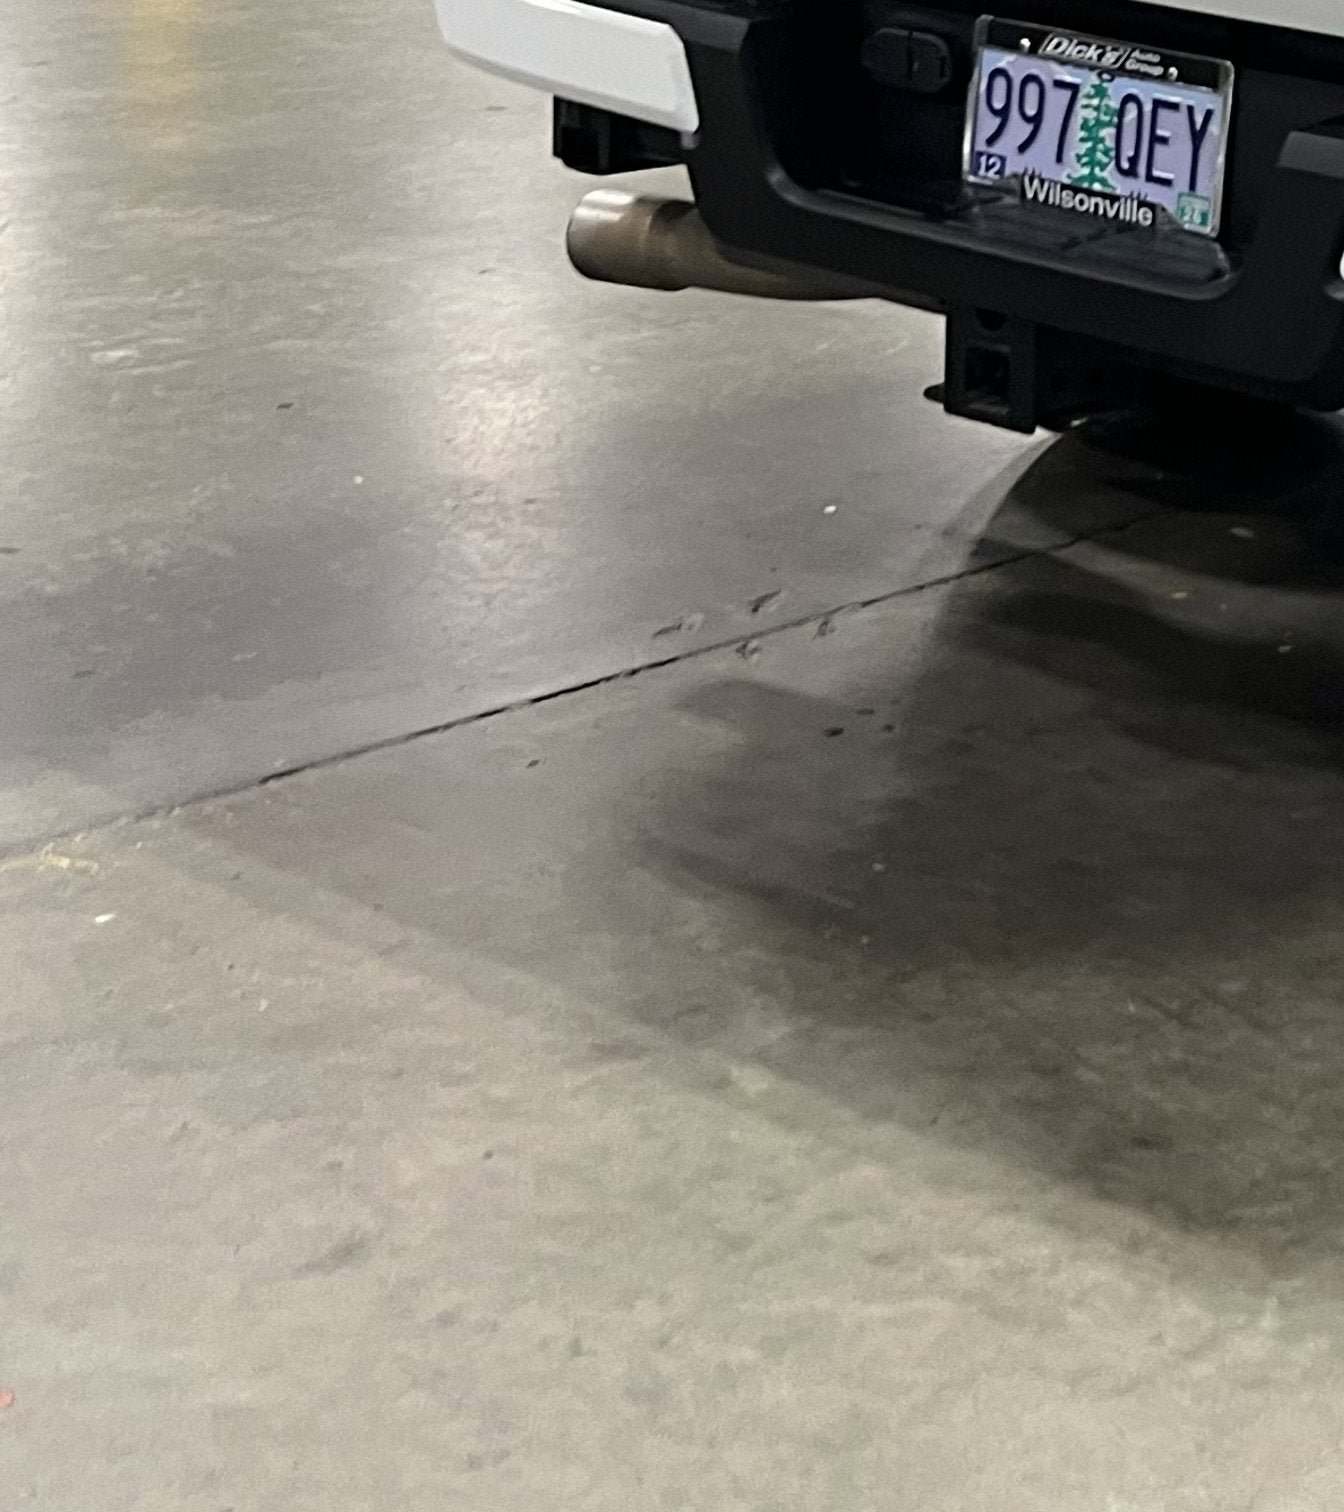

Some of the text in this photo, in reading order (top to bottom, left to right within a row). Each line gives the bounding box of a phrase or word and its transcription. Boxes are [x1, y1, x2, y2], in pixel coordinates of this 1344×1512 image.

[985, 66, 1216, 192] 997 QEY
[979, 155, 1001, 176] 12
[1024, 176, 1153, 226] Wilsonville
